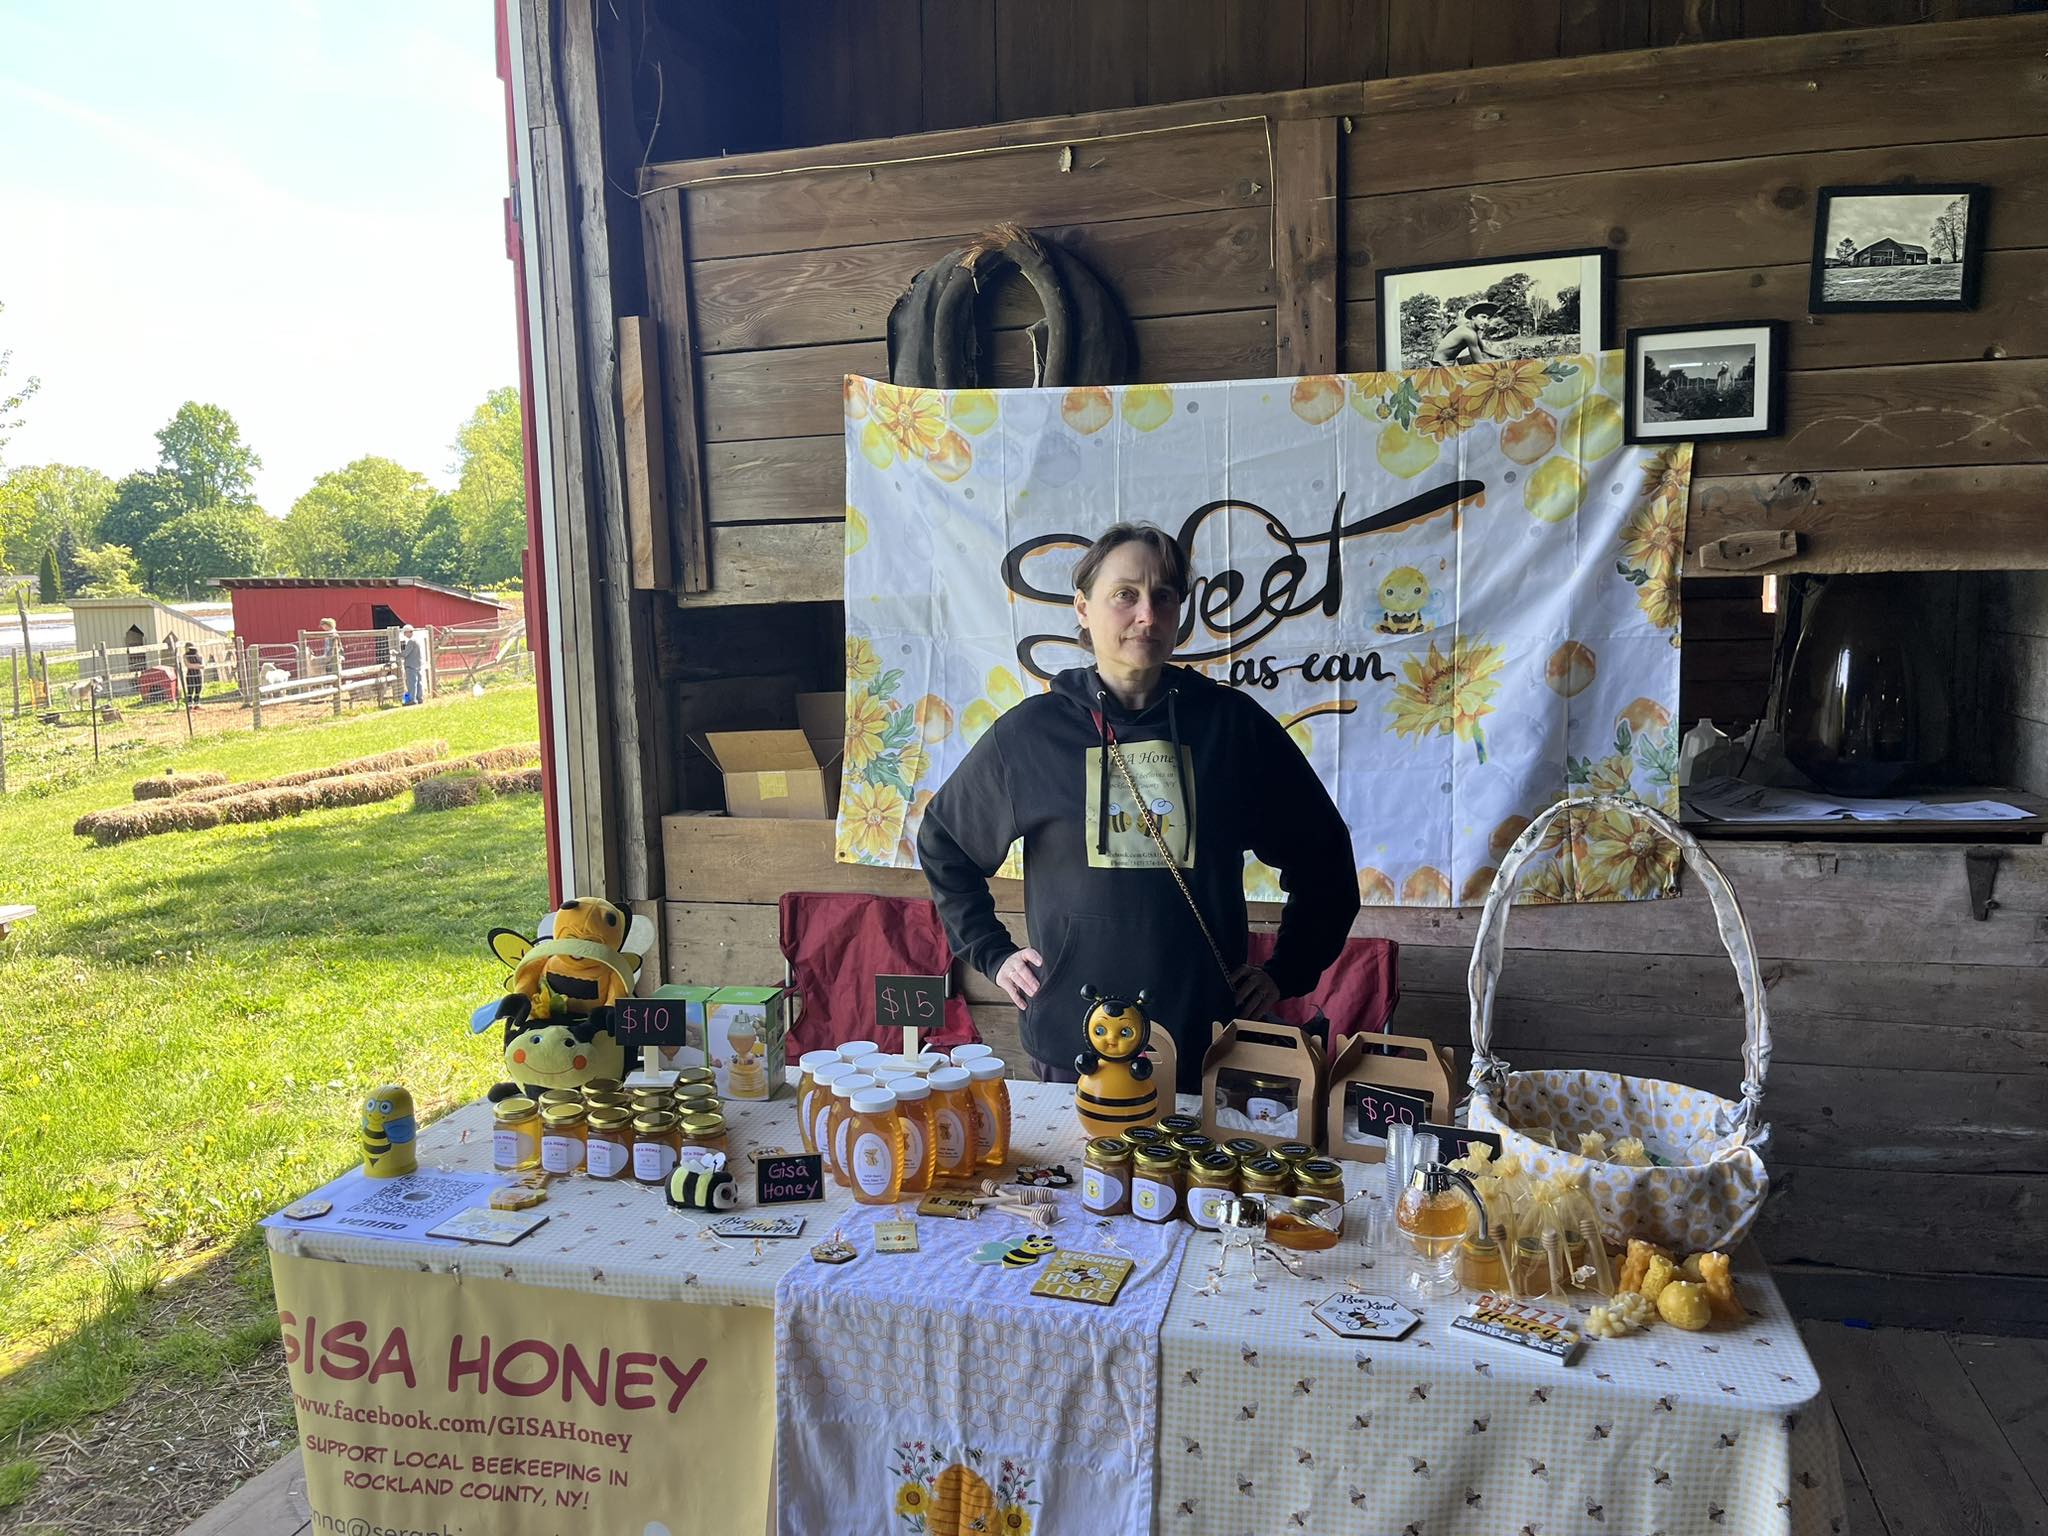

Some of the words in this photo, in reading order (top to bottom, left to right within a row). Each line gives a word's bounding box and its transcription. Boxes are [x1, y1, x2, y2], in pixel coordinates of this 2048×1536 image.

[1228, 655, 1280, 690] as
[1299, 651, 1396, 683] can
[1139, 750, 1176, 767] Hone
[881, 986, 936, 1020] $15
[621, 1005, 670, 1034] $10
[1361, 1097, 1414, 1127] $20
[768, 1162, 810, 1179] Gisa
[764, 1180, 818, 1200] Honey
[337, 1216, 409, 1231] venmo
[447, 1333, 708, 1414] HONEY
[306, 1435, 388, 1462] SUPPORT
[394, 1450, 464, 1472] LOCAL
[472, 1456, 602, 1483] BEEKEEPING
[609, 1469, 629, 1487] IN
[344, 1470, 454, 1496] ROCKLAND
[460, 1482, 548, 1508] COUNTY,
[555, 1489, 590, 1510] NY!
